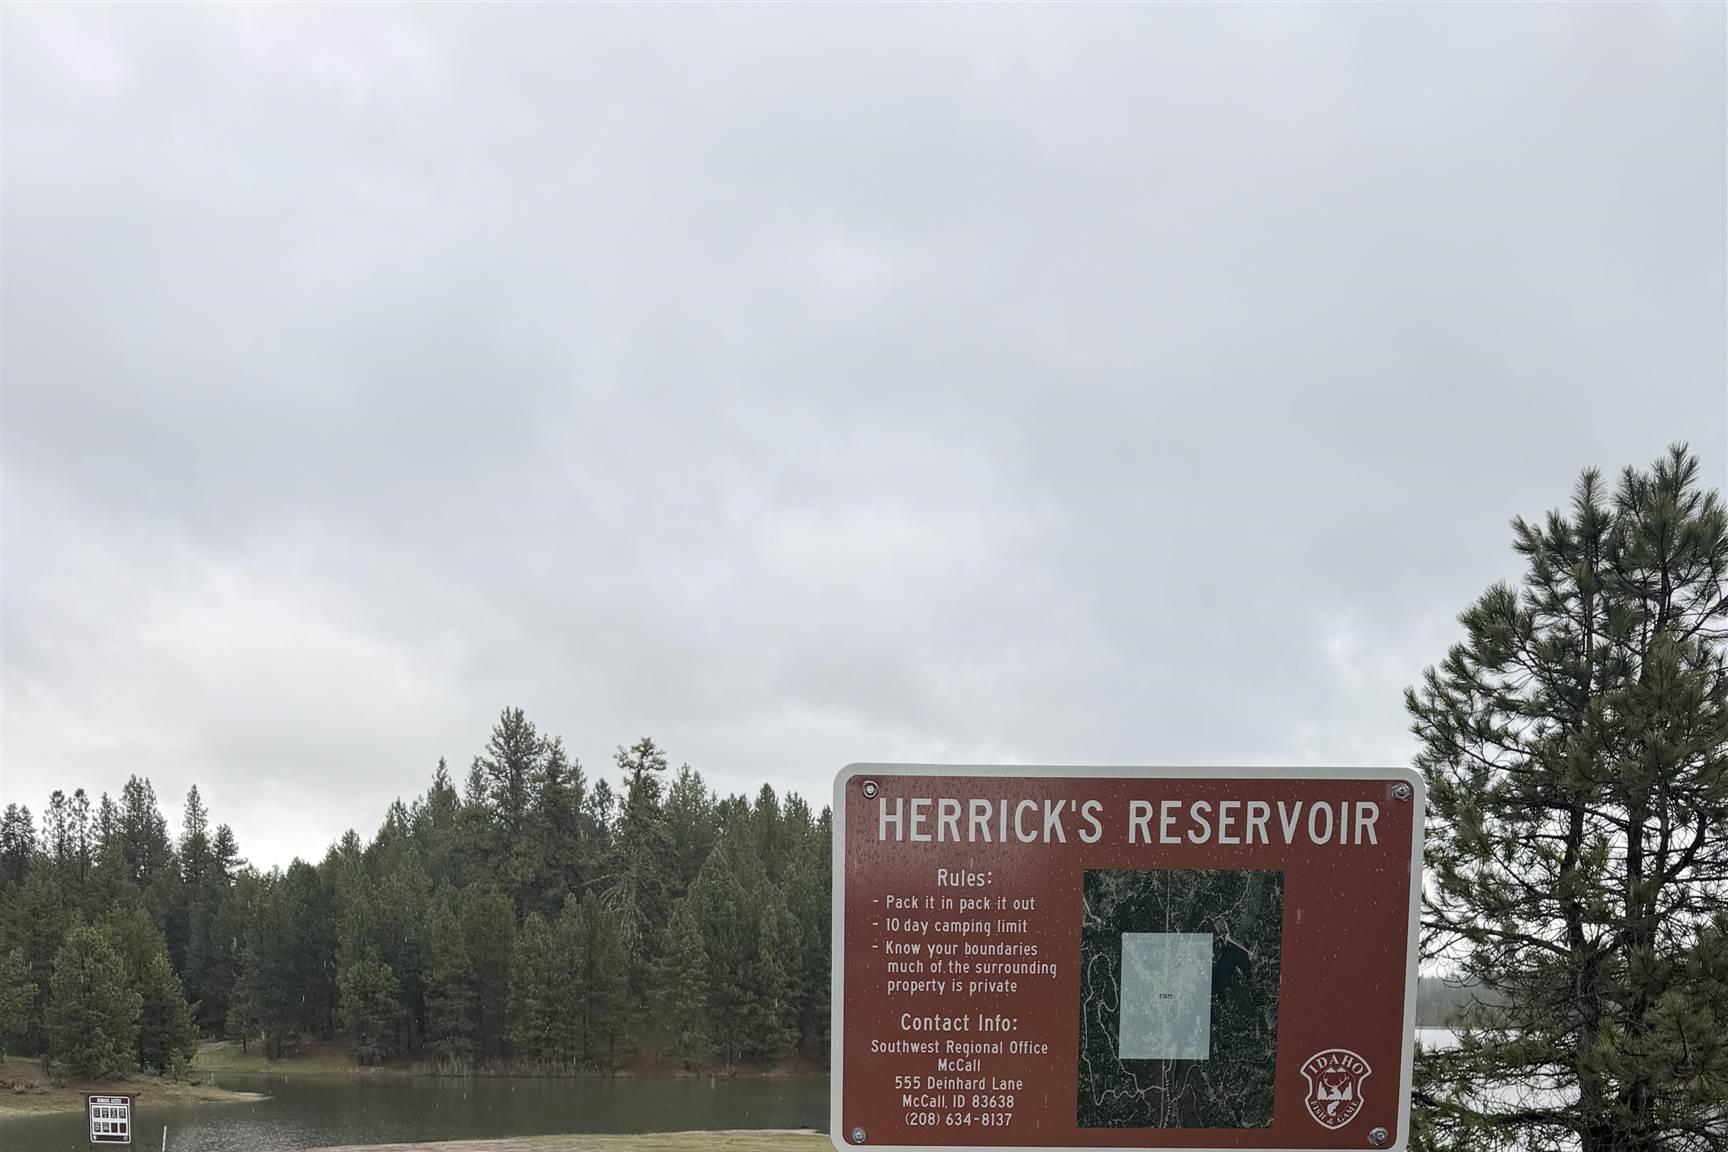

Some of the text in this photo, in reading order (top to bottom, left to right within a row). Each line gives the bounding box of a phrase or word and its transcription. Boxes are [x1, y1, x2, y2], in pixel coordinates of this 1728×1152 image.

[879, 797, 1380, 844] HERRICK'S RESERVOIR
[937, 868, 992, 887] Rules:
[886, 895, 919, 909] Pack
[925, 896, 935, 909] it
[941, 896, 953, 910] in
[959, 896, 990, 913] pack
[997, 897, 1007, 910] it
[1013, 897, 1035, 911] out
[886, 918, 900, 932] 10
[903, 918, 929, 935] day
[934, 920, 991, 937] camping
[997, 920, 1028, 933] limit
[886, 940, 921, 954] Know
[927, 944, 959, 958] your
[965, 942, 1038, 956] boundaries
[887, 960, 1057, 978] much of the surrounding
[887, 979, 1018, 996] property is private
[901, 1013, 1018, 1031] Contact Info:
[871, 1039, 1049, 1057] Southwest Regional Office
[938, 1058, 981, 1072] McCall
[1308, 1054, 1364, 1074] IDAHO
[895, 1076, 1023, 1090] 555 Deinhard Lane
[902, 1094, 1014, 1109] McCall, ID 83638
[905, 1112, 1013, 1127] (208) 634-8137
[1310, 1100, 1327, 1120] FISH
[1337, 1100, 1359, 1122] GAME
